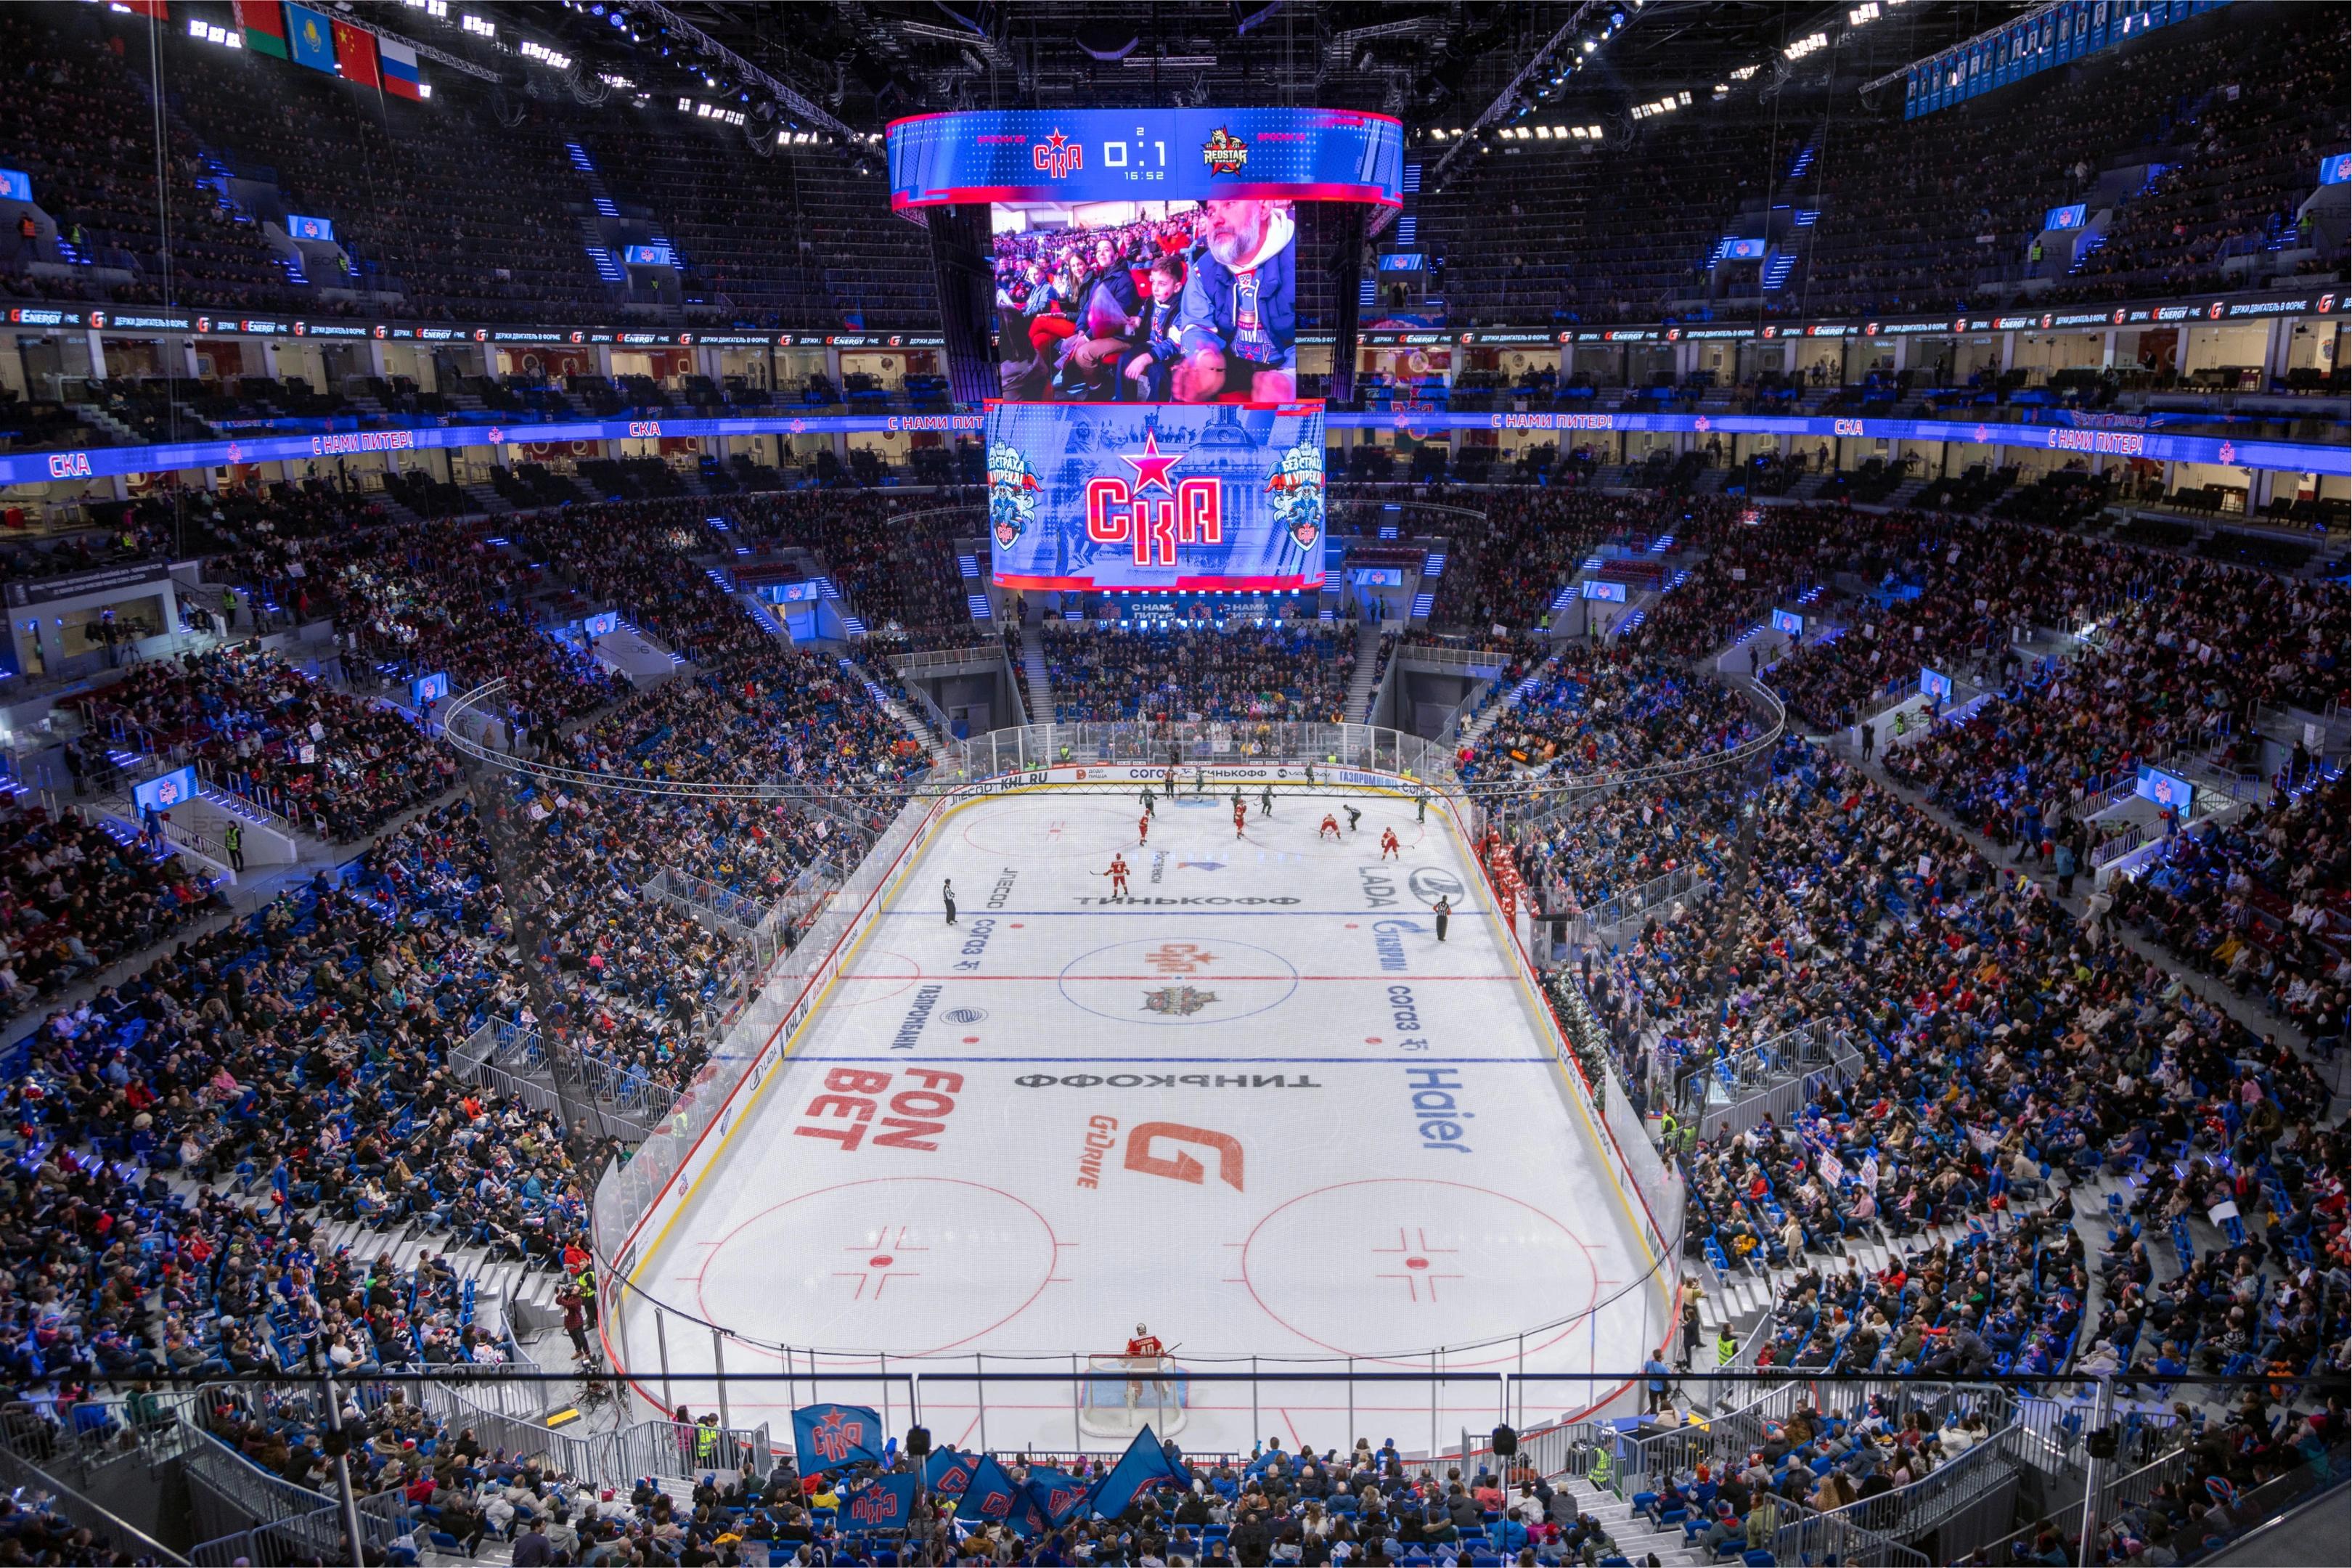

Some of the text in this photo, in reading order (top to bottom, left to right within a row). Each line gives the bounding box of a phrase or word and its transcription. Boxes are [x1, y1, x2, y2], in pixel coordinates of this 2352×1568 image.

[1033, 144, 1083, 179] СКА
[1124, 171, 1164, 180] 16:52
[629, 422, 661, 436] СКА
[888, 415, 984, 430] С НАМИ ПИТ
[1491, 414, 1612, 429] С НАМИ ПИТЕР!
[1834, 419, 1863, 436] СКА
[312, 430, 415, 455] С НАМИ ПИТЕР!
[2048, 428, 2143, 455] С НАМИ ПИТЕР!
[49, 452, 92, 478] СКА
[1281, 458, 1299, 472] БЕЗ
[1284, 473, 1293, 485] И
[1085, 476, 1223, 567] СКА
[1001, 772, 1048, 791] KHL.RU
[1358, 865, 1400, 909] LADA
[1075, 897, 1301, 905] ТИНЬКОФФ
[785, 995, 809, 1042] KHL.RU
[890, 984, 943, 1050] ГАЗПРОМБАНК
[1014, 1073, 1322, 1088] ТИНЬКОФФ
[793, 1066, 893, 1152] BET
[873, 1067, 965, 1151] FON
[1405, 1068, 1475, 1153] Haier
[813, 1420, 863, 1462] СКА
